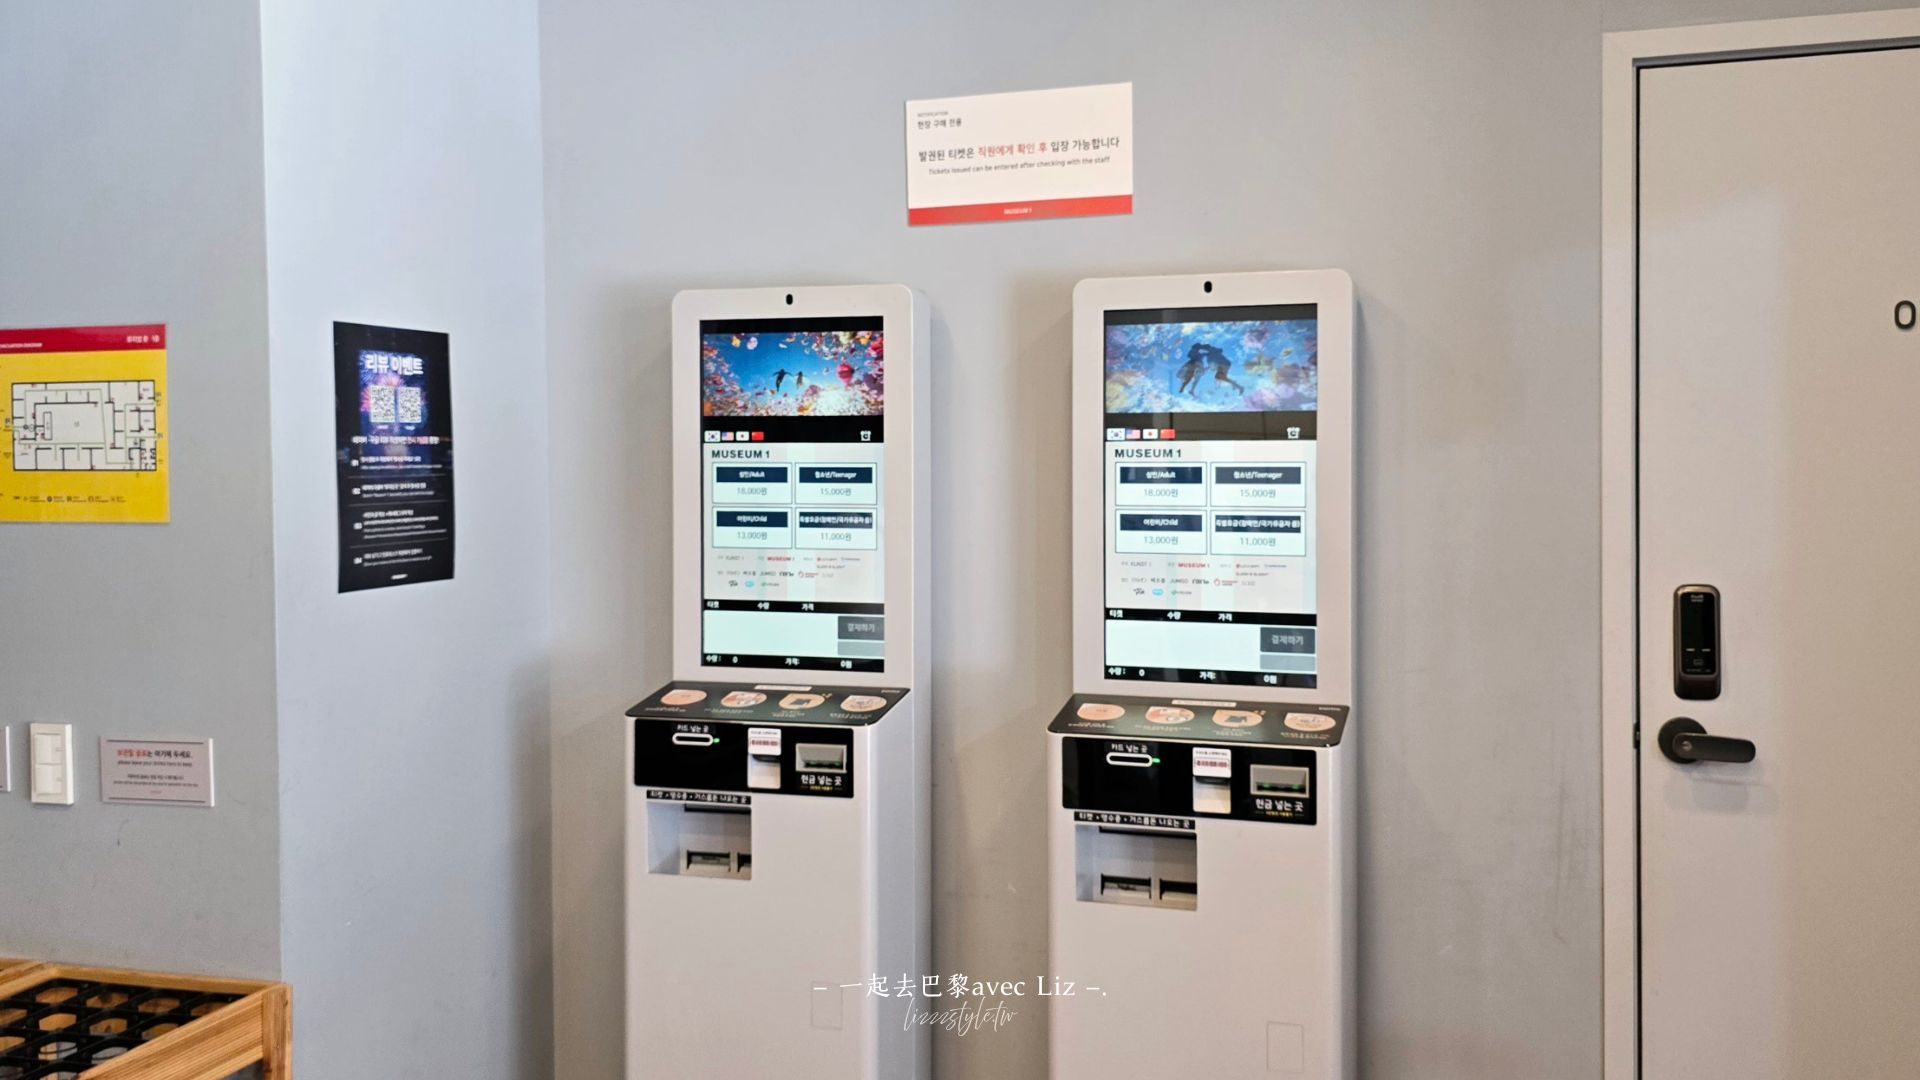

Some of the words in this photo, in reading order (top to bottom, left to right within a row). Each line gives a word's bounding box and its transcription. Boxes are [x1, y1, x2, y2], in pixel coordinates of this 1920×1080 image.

[917, 120, 931, 130] 현장
[933, 119, 947, 128] 구매
[949, 118, 962, 127] 전용
[918, 149, 945, 162] 발권된
[948, 147, 974, 159] 티켓은
[978, 144, 1014, 157] 직원에게
[1018, 143, 1035, 154] 확인
[1039, 142, 1048, 153] 후
[1050, 140, 1069, 153] 입장
[1072, 137, 1120, 151] 가능합니다
[951, 166, 971, 174] issued
[994, 163, 1018, 171] entered
[1020, 161, 1035, 169] after
[1036, 159, 1066, 168] checking
[364, 353, 389, 374] 리뷰
[390, 355, 424, 376] 이벤트
[711, 449, 762, 458] MUSEUM
[765, 450, 770, 458] 1
[1114, 448, 1173, 458] MUSEUM
[1176, 449, 1182, 458] 1
[821, 488, 852, 496] 15,000원
[1143, 488, 1178, 497] 18,000원
[1240, 489, 1276, 498] 15,000원
[821, 533, 852, 541] 11,000원
[1143, 536, 1178, 545] 13,000원
[1240, 537, 1276, 547] 11,000원
[1109, 609, 1123, 618] 티켓
[1166, 611, 1181, 620] 수량
[1217, 613, 1233, 621] 가격
[1271, 634, 1304, 645] 결제하기
[1138, 668, 1145, 677] 0
[1111, 743, 1125, 751] 카드
[1126, 744, 1139, 753] 넣는
[1141, 745, 1148, 754] 곳
[801, 774, 816, 785] 현금
[817, 775, 832, 786] 넣는
[834, 776, 843, 787] 곳
[1255, 798, 1273, 810] 현금
[1275, 800, 1293, 812] 넣는
[1294, 801, 1304, 812] 곳
[1100, 812, 1121, 824] 영수증
[1129, 815, 1157, 826] 거스름돈
[1159, 817, 1180, 828] 나오는
